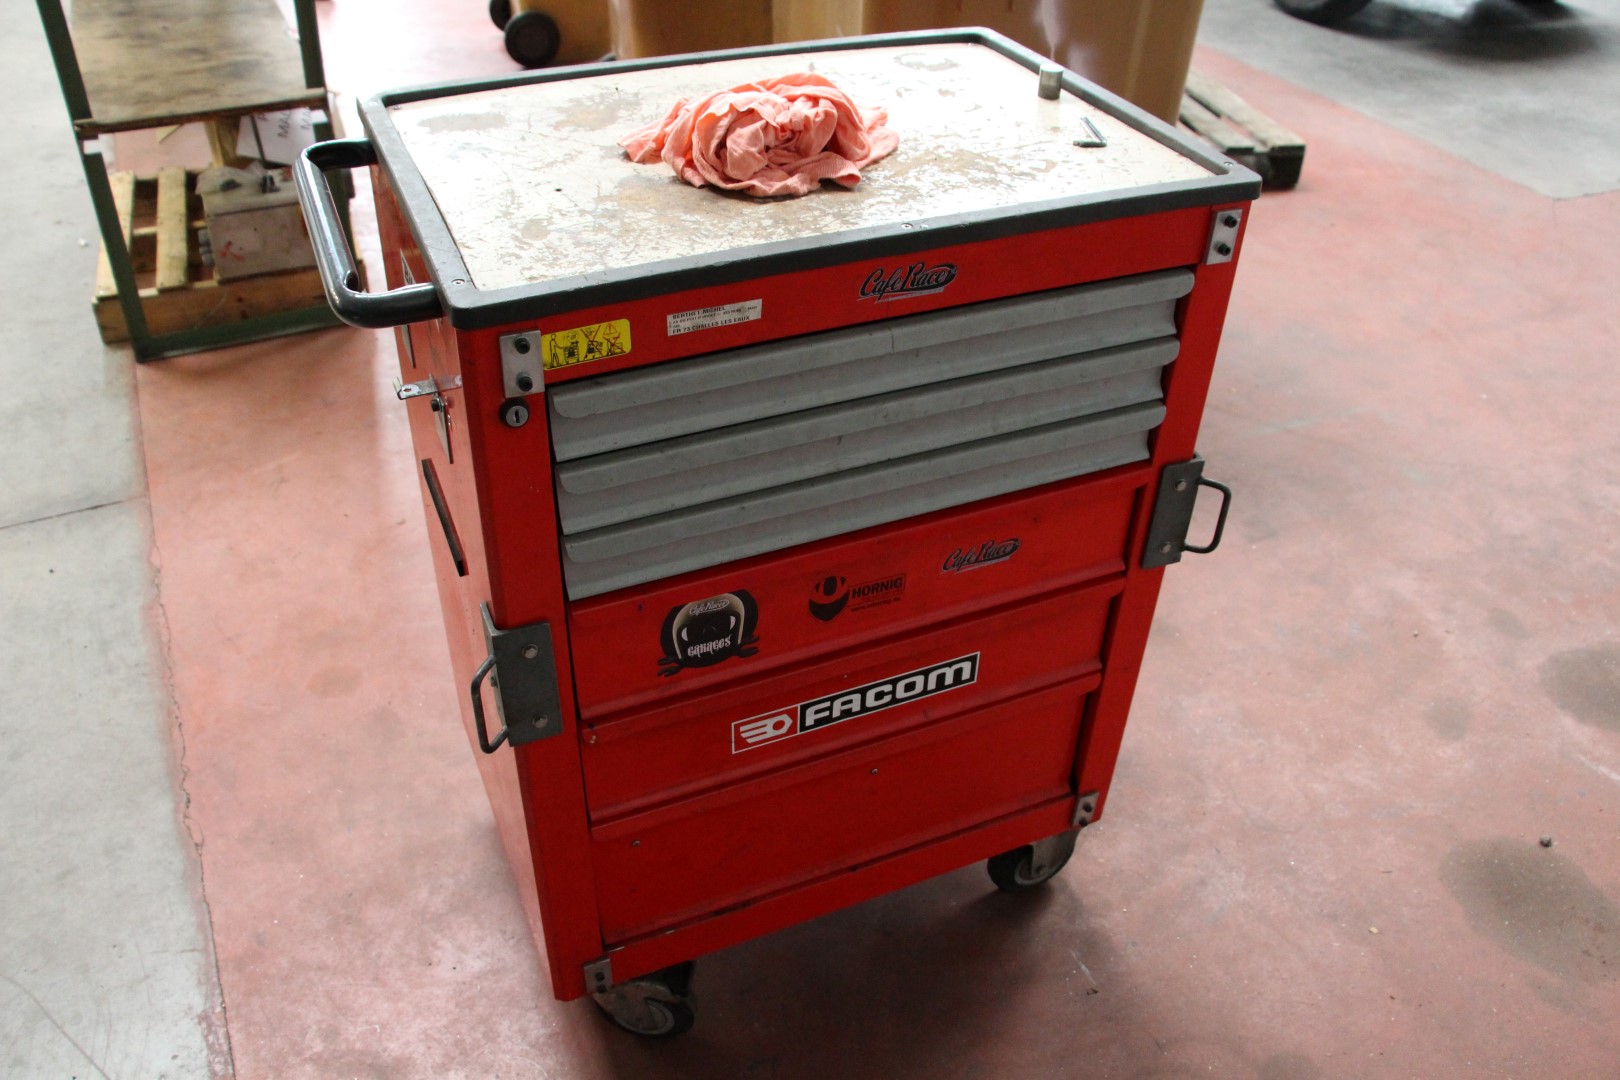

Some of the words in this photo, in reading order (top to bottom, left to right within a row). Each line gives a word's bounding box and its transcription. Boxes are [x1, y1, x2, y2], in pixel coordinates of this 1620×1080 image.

[702, 306, 726, 314] MICHEL
[691, 321, 719, 331] CHALLES
[733, 315, 750, 323] EAUX
[851, 576, 903, 599] HORNIG
[805, 660, 973, 727] FACOM
